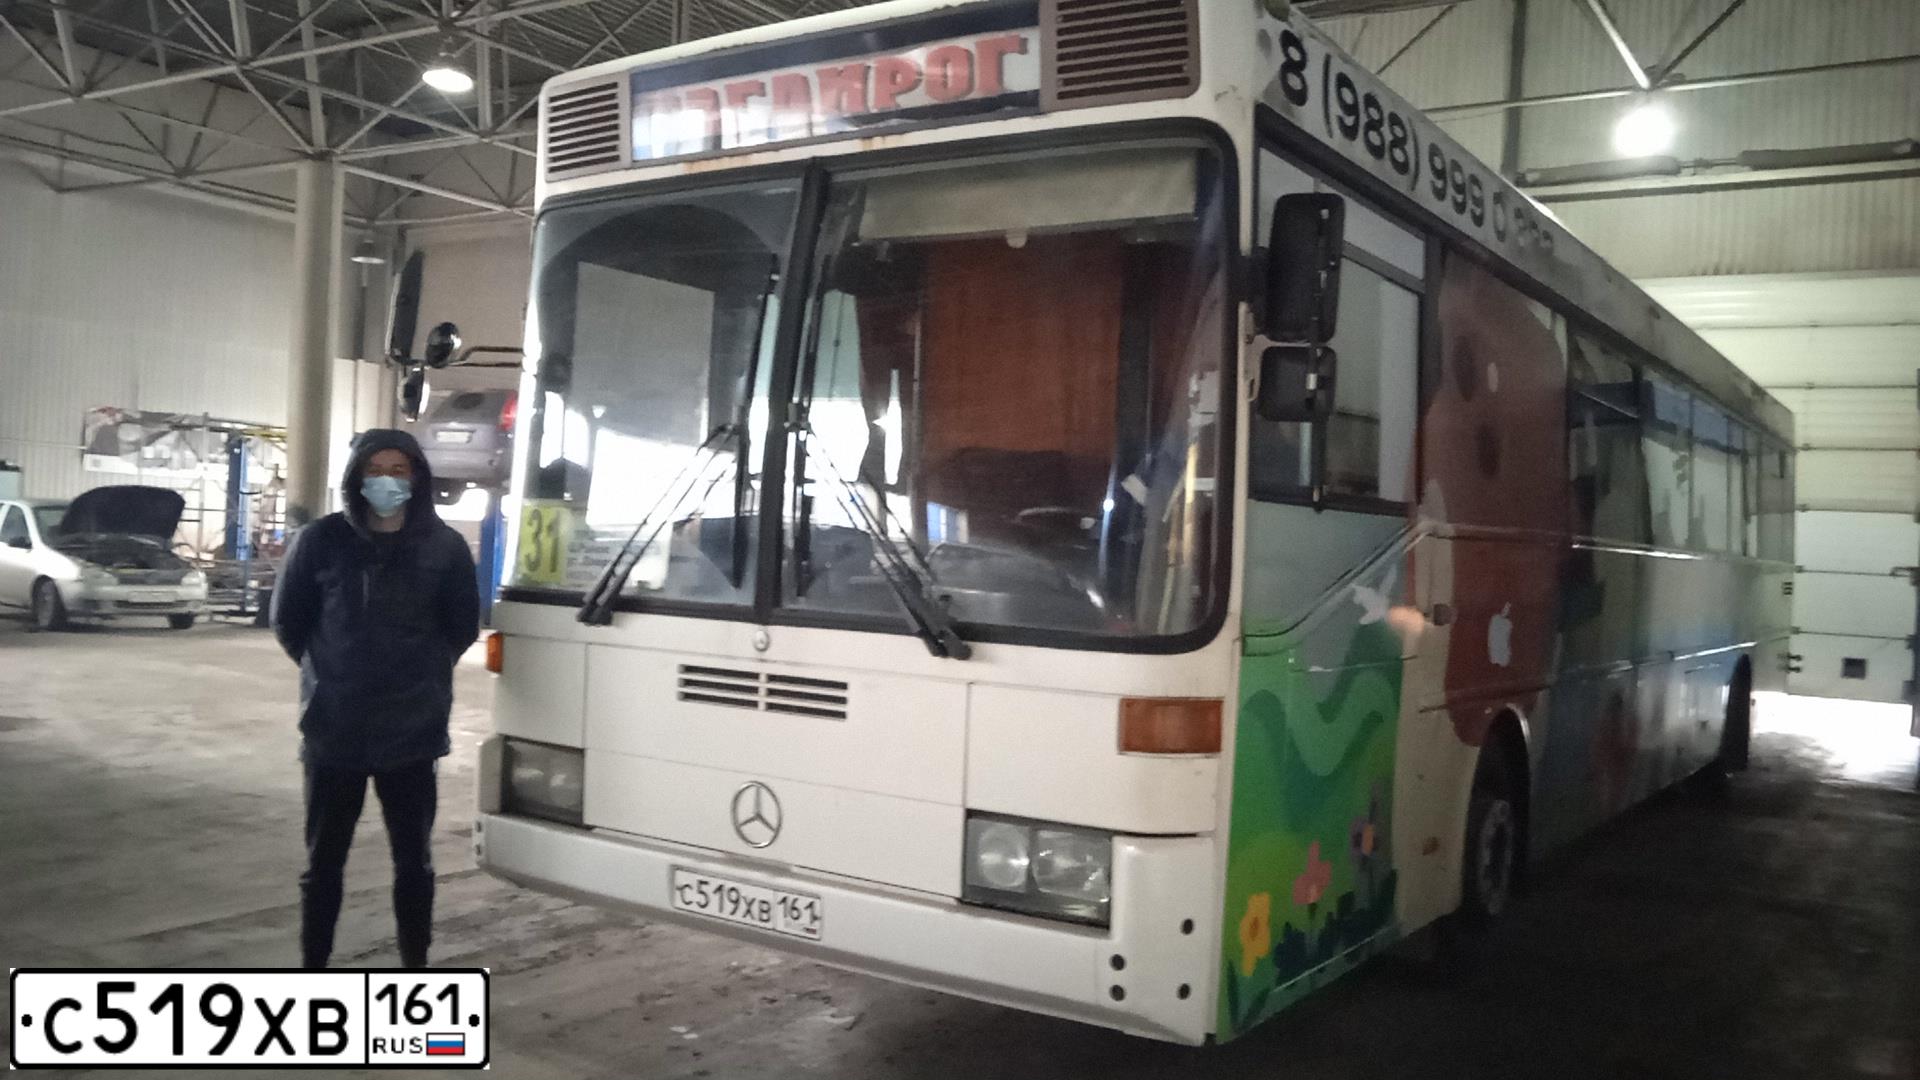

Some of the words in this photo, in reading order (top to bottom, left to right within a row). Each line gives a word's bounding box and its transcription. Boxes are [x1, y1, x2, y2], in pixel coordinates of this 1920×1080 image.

[1279, 29, 1308, 107] 8
[1322, 53, 1420, 191] (988)
[524, 508, 560, 573] 31
[678, 879, 772, 923] С519ХВ
[777, 896, 815, 924] 161
